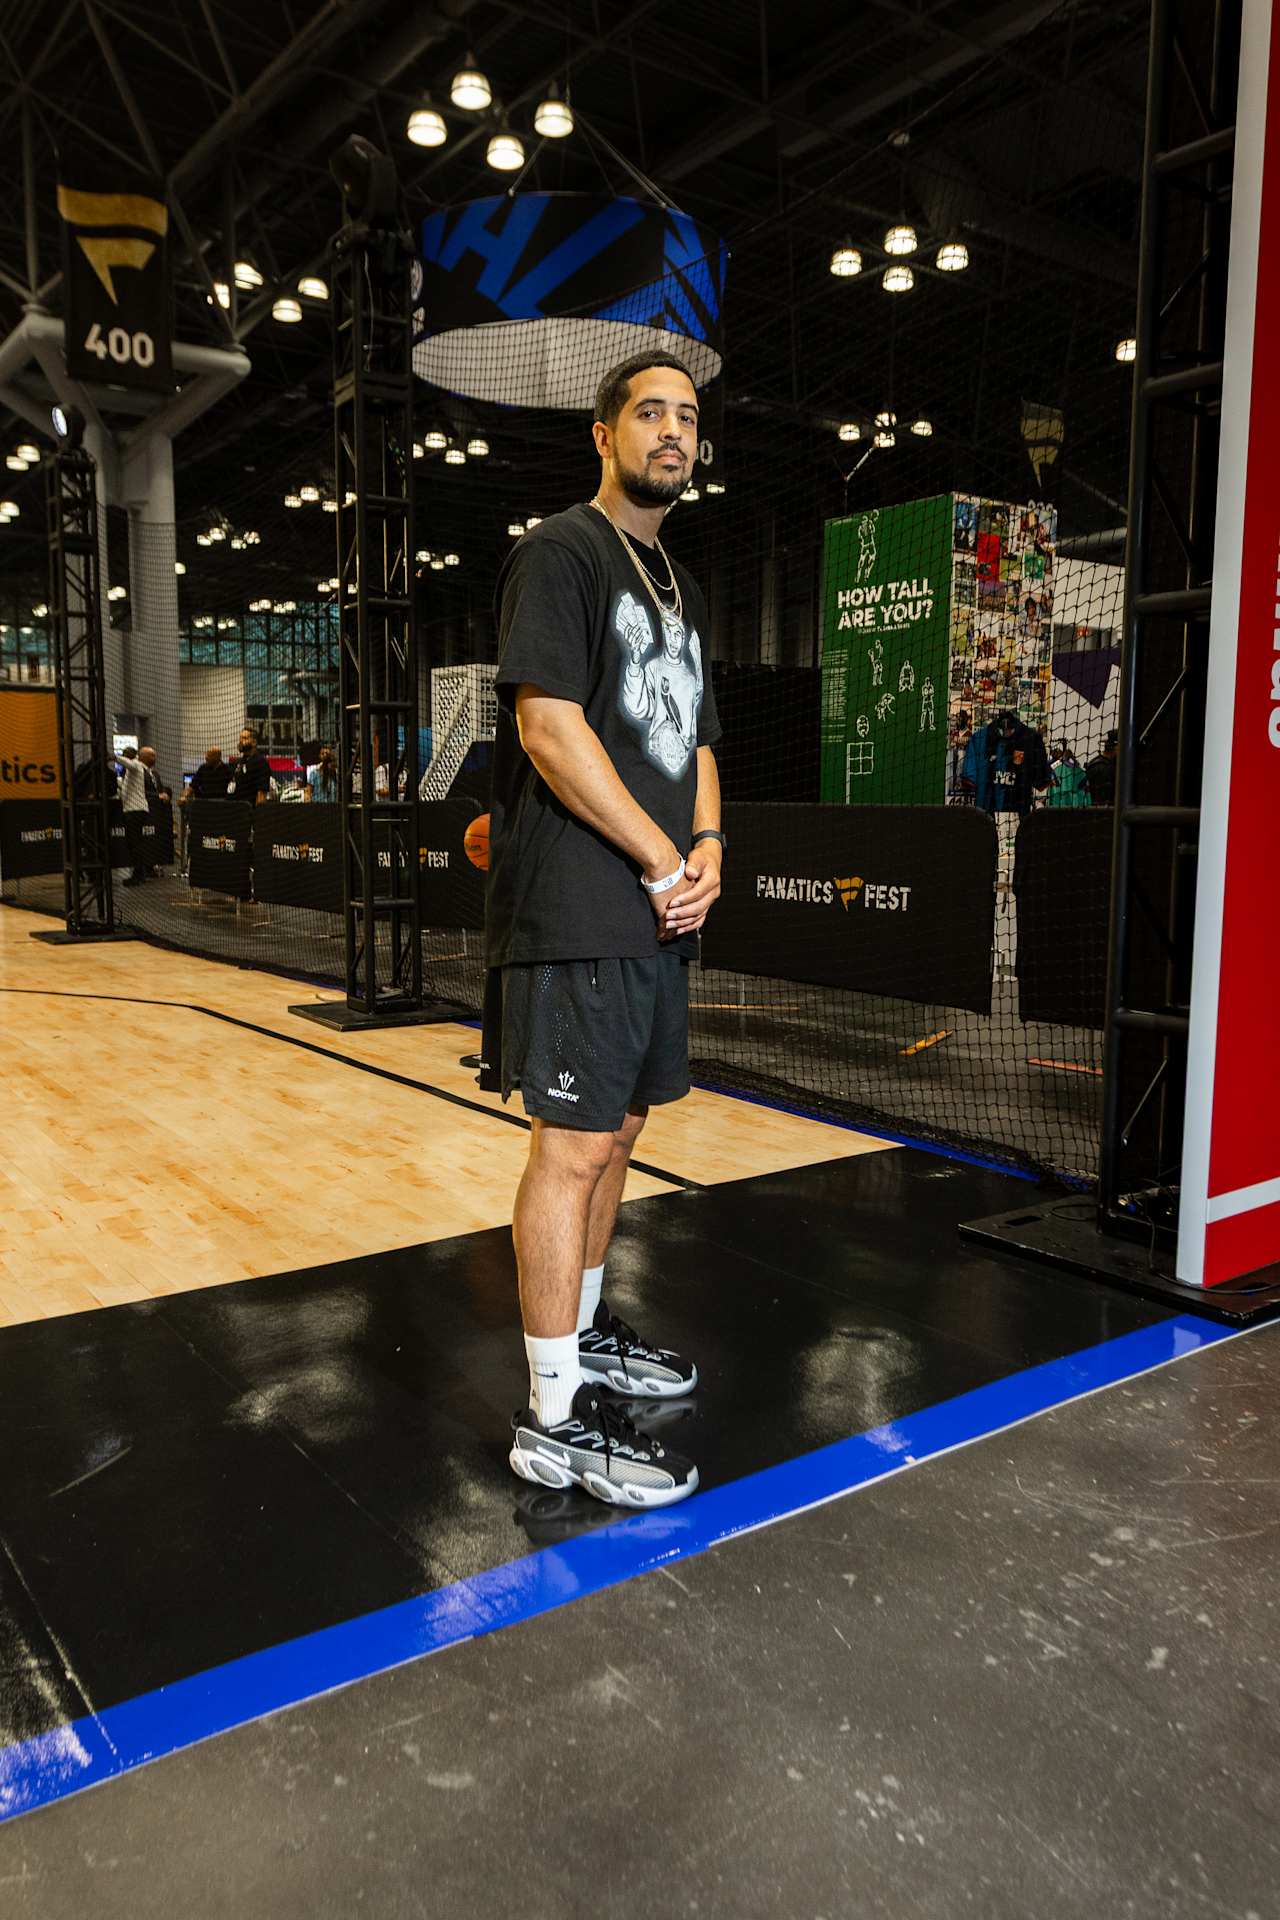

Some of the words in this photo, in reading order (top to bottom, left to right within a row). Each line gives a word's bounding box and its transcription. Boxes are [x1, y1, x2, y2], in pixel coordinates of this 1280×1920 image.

[84, 322, 155, 368] 400
[837, 584, 883, 609] HOW
[887, 577, 934, 600] TALL
[837, 606, 876, 631] ARE
[880, 598, 934, 624] YOU?
[308, 847, 323, 862] FEST
[427, 850, 449, 869] FEST
[756, 874, 834, 904] FANATICS
[864, 883, 912, 912] FEST
